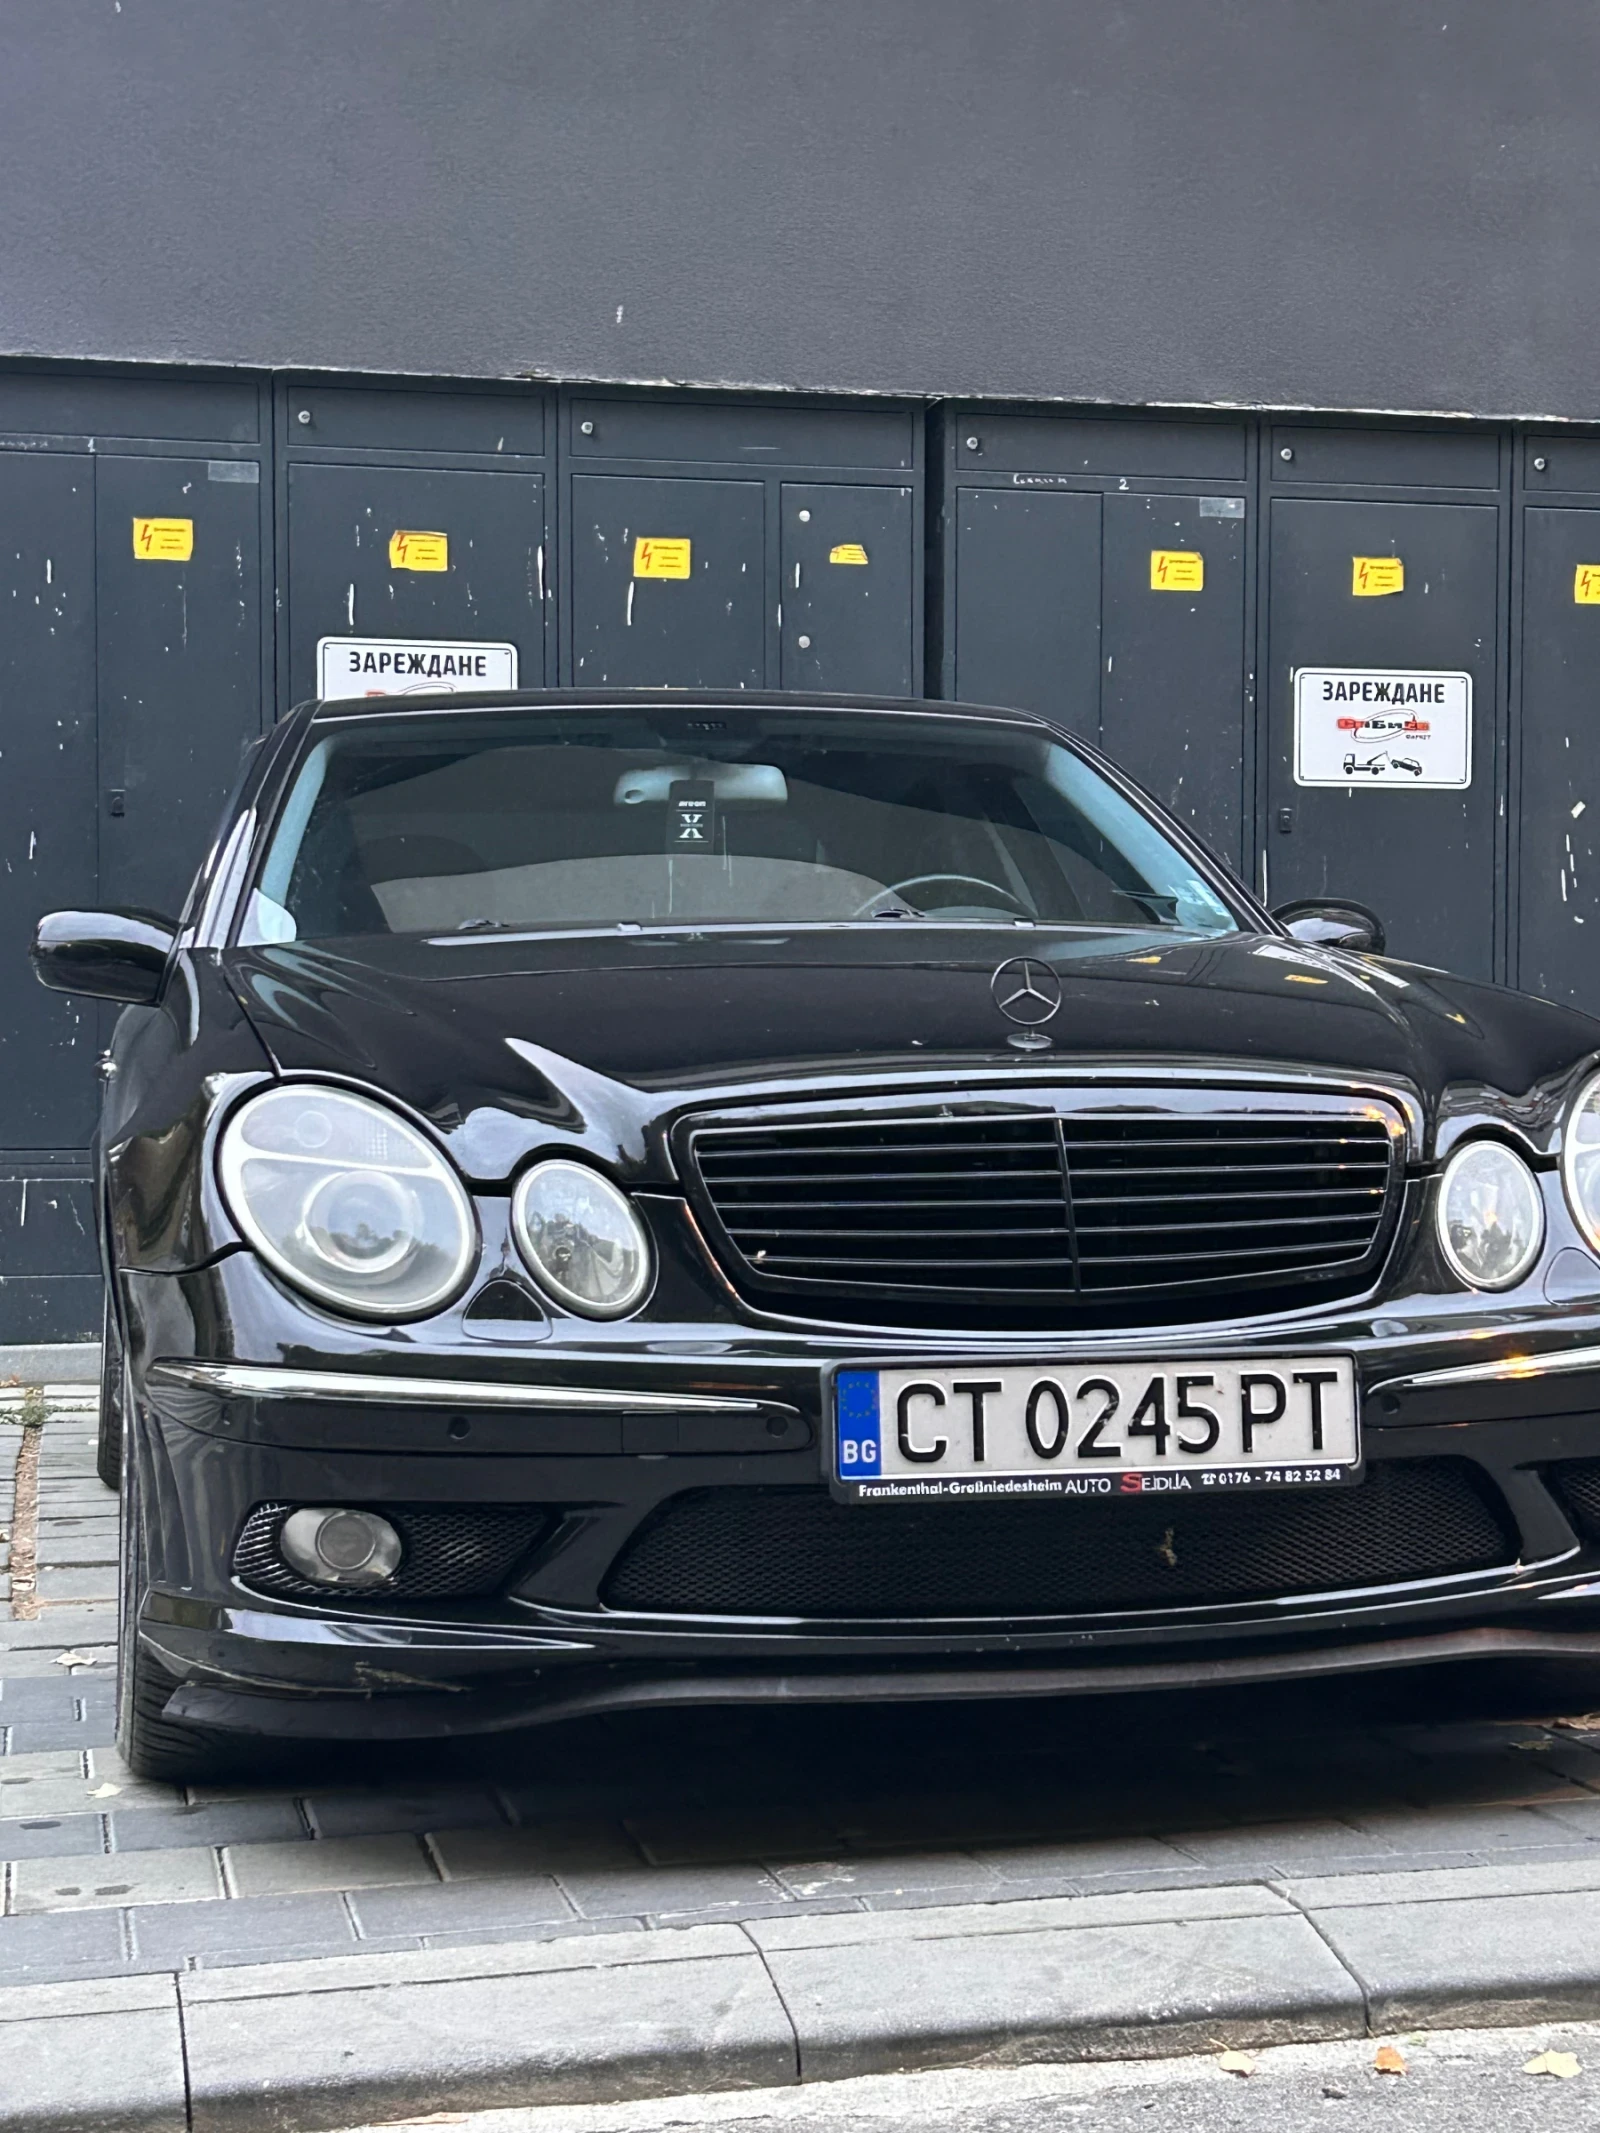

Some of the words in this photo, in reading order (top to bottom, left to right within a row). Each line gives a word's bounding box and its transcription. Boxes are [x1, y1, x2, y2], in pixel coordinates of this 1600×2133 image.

[1119, 479, 1130, 491] 2
[349, 651, 487, 678] ЗАРЕЖДАНЕ
[1322, 681, 1446, 705] ЗАРЕЖДАНЕ
[1026, 1374, 1220, 1459] 0245
[843, 1440, 876, 1464] BG
[1065, 1478, 1112, 1494] AUTO
[1285, 1469, 1301, 1482] 82
[1305, 1468, 1321, 1481] 52
